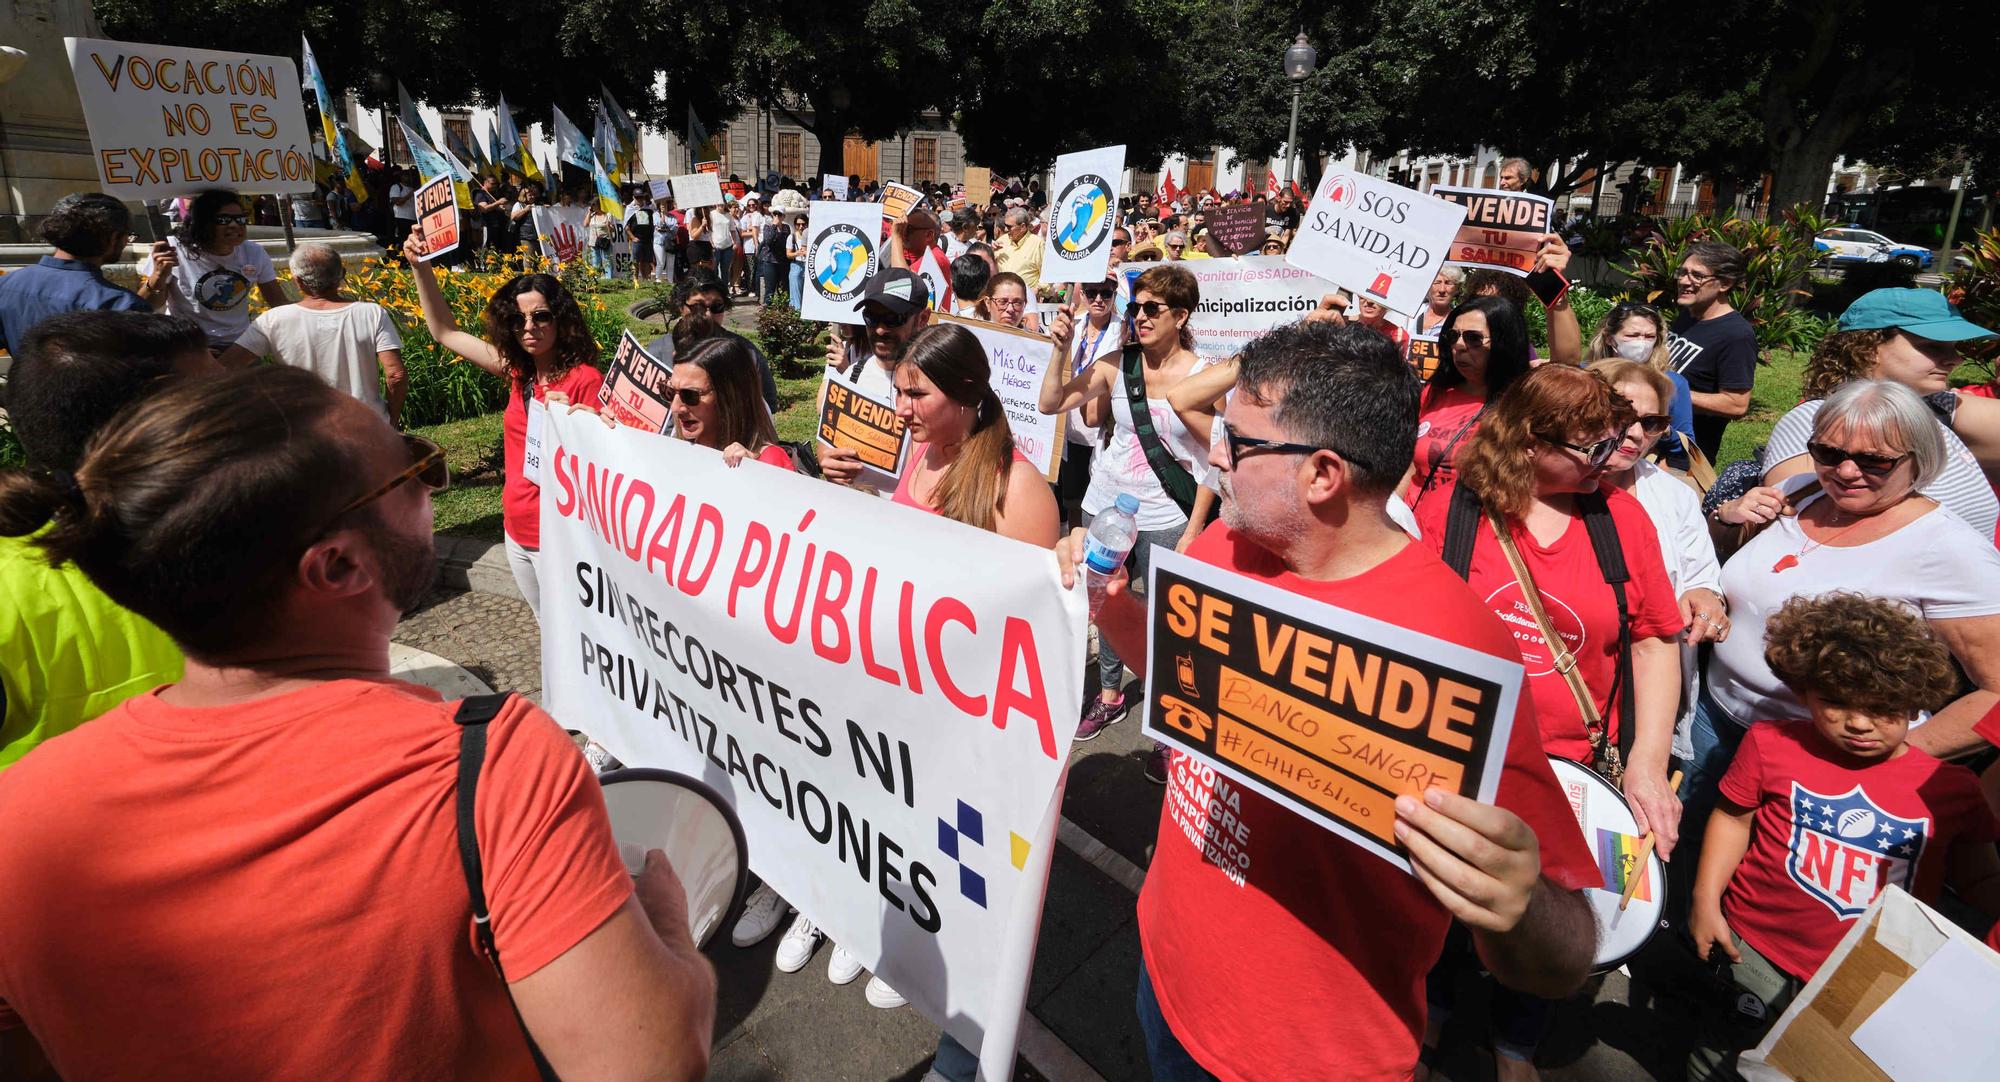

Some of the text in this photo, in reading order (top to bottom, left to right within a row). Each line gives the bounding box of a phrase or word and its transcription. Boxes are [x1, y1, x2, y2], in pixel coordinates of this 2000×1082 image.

[91, 52, 278, 100] VOCACIÓN
[162, 103, 278, 139] NO ES
[101, 144, 315, 186] EXPLOTACIÓN
[424, 178, 453, 211] VENDE
[893, 188, 920, 203] VENDE
[1358, 190, 1411, 224] SOS
[1466, 196, 1546, 228] VENDE
[430, 230, 454, 251] SALUD
[433, 213, 443, 230] TU
[1050, 199, 1115, 261] SANIDAD CANARIA UNIDA
[1311, 210, 1430, 270] SANIDAD
[1482, 229, 1508, 246] TU
[808, 243, 875, 302] SANIDAD CANARIA UNIDA
[1461, 246, 1525, 268] SALUD
[617, 336, 632, 366] SE
[1412, 341, 1429, 356] SE
[629, 390, 644, 411] TU
[828, 383, 905, 436] SE VENDE
[1006, 409, 1037, 425] TRABAJO
[553, 445, 1058, 760] SANIDAD PÚBLICA
[575, 561, 915, 809] SIN RECORTES NI
[1166, 583, 1483, 752] SE VENDE
[1220, 677, 1320, 738] BANCO
[580, 631, 942, 935] PRIVATIZACIONES
[1189, 755, 1241, 815] DONA
[1177, 764, 1251, 847] SANGRE
[1179, 814, 1247, 888] PRIVATIZACIÓN
